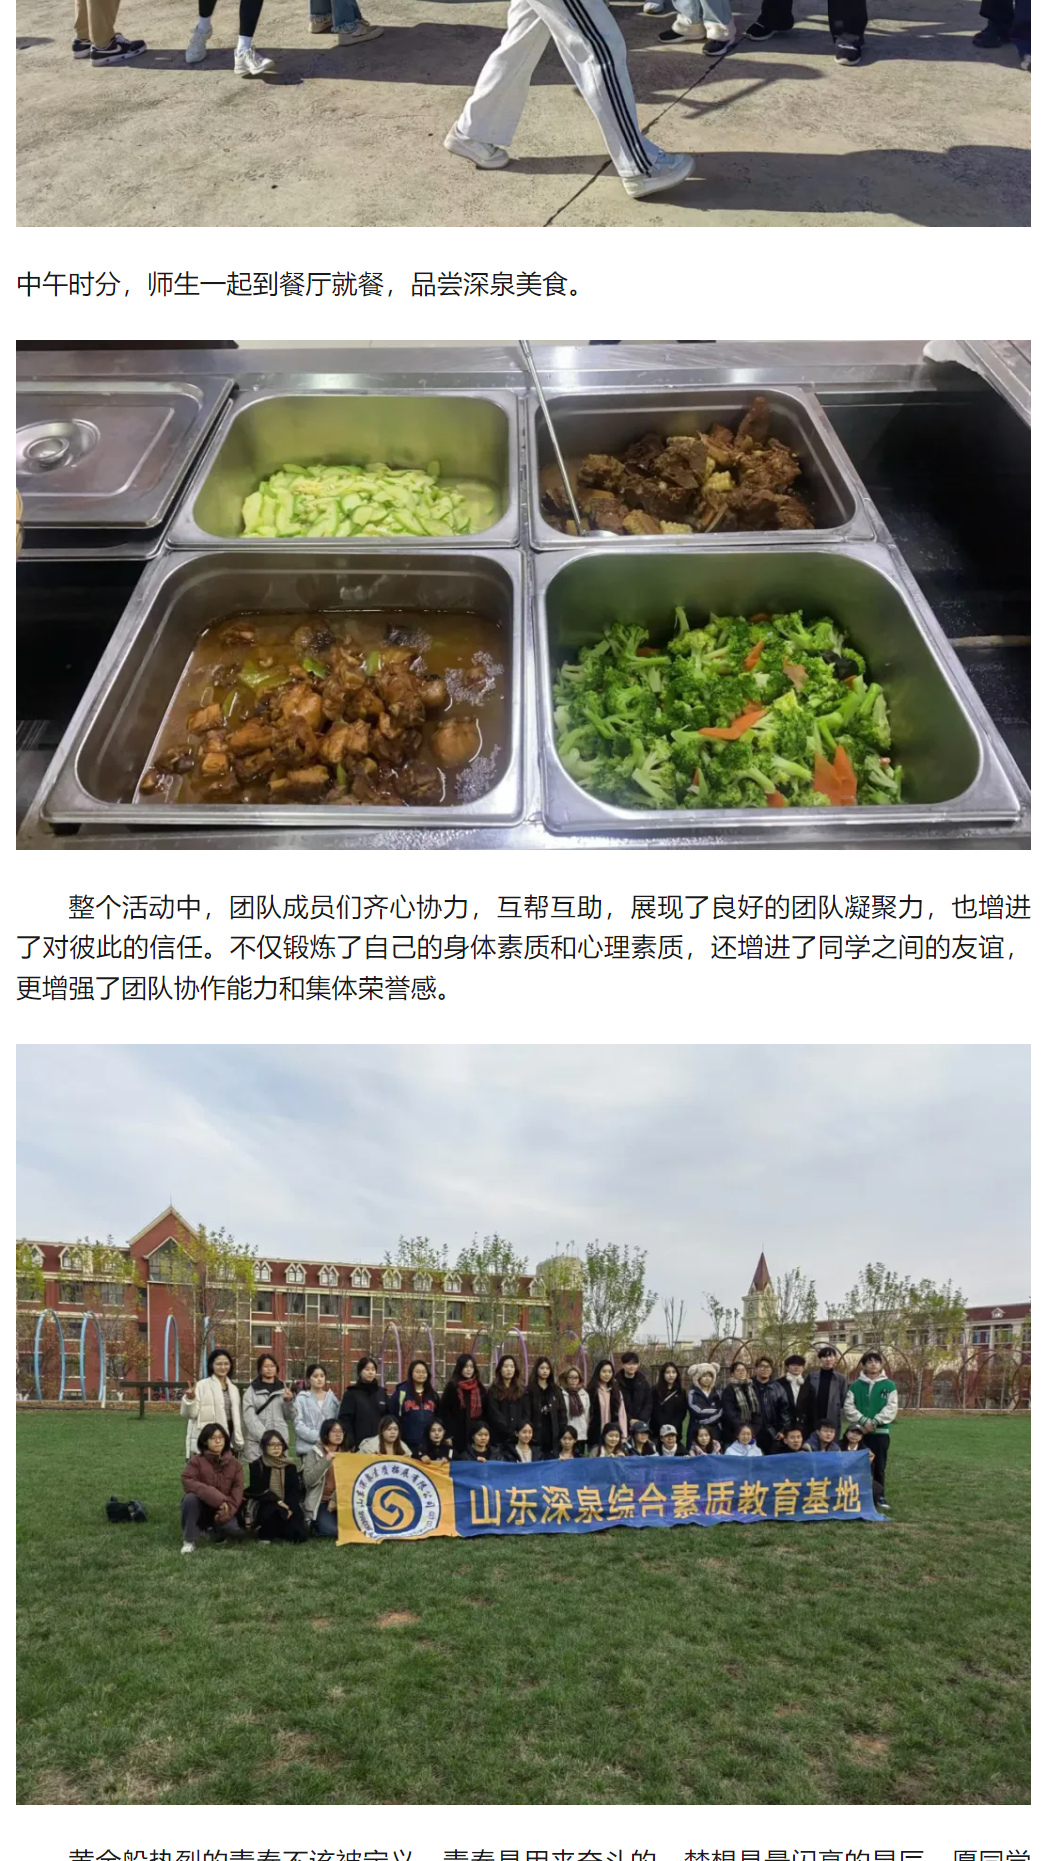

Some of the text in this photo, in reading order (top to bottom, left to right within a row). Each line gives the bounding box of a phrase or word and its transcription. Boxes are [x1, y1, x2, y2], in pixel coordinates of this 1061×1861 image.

[17, 270, 578, 298] 中午时分，师生一起到餐厅就餐，品尝深泉美食。
[68, 893, 1031, 921] 整个活动中，团队成员们齐心协力，互帮互助，展现了良好的团队凝聚力，也增进
[16, 933, 1014, 961] 了对彼此的信任。不仅锻炼了自己的身体素质和心理素质，还增进了同学之间的友谊，
[16, 974, 446, 1002] 更增强了团队协作能力和集体荣誉感。
[470, 1475, 861, 1527] 山东深泉综合素质教育基地
